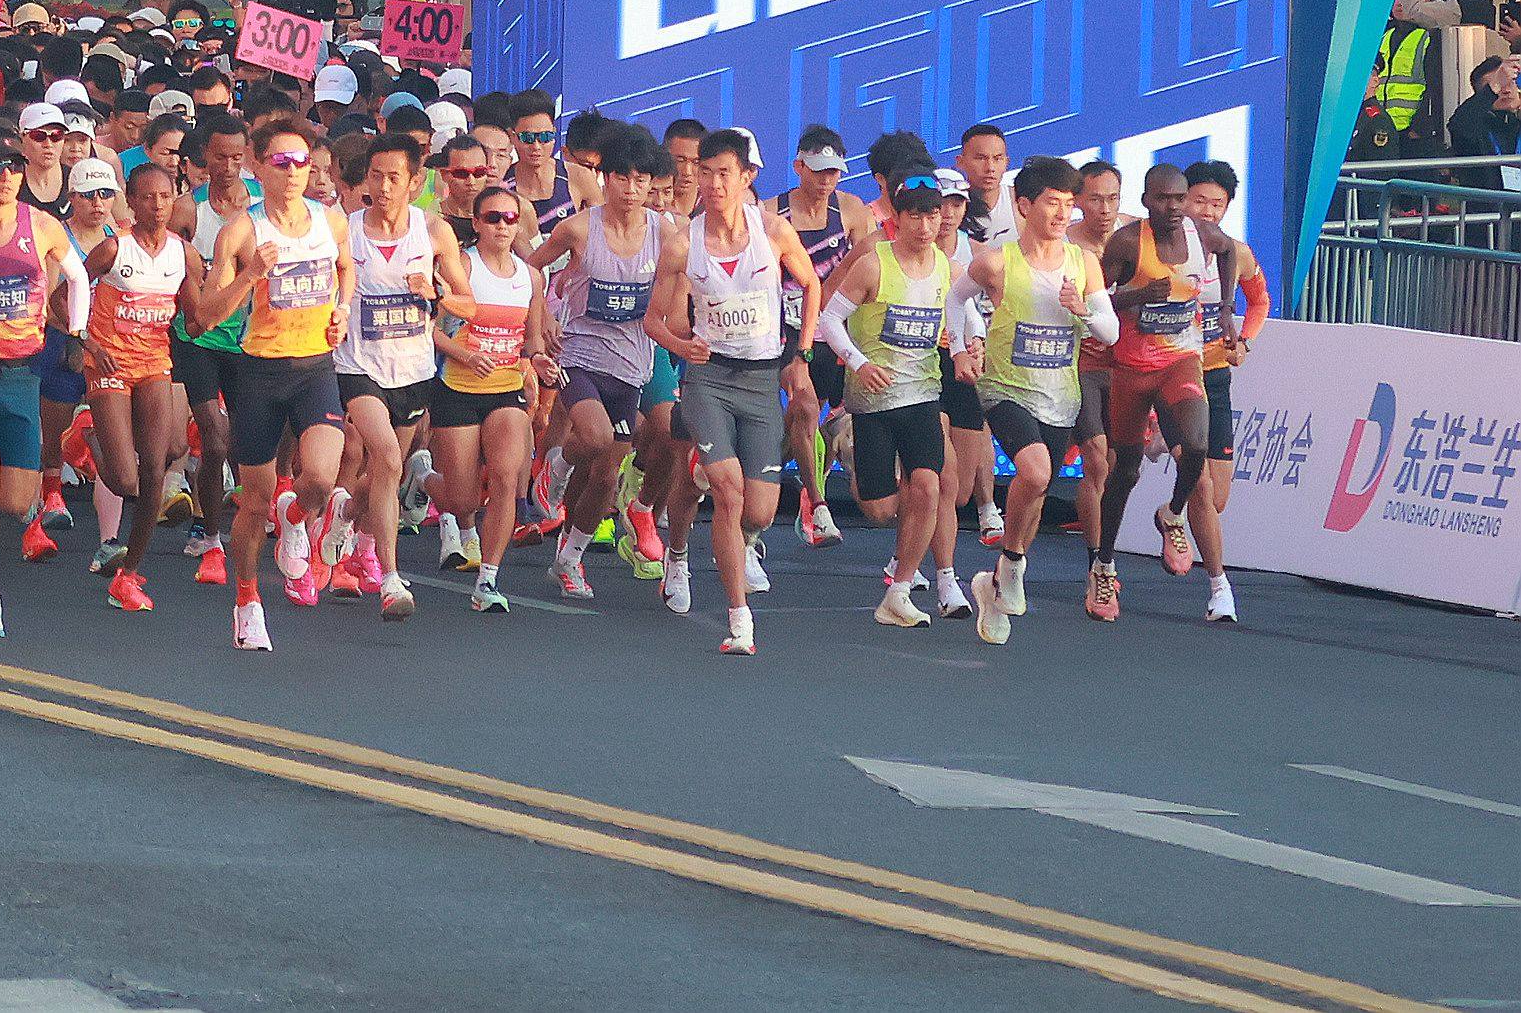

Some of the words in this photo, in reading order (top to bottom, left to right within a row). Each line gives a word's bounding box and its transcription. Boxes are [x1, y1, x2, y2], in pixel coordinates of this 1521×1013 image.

[251, 10, 311, 60] 3:00
[394, 4, 454, 46] 4:00
[606, 296, 636, 311] 马瑞
[707, 308, 758, 327] A10002
[1392, 408, 1521, 510] 东浩兰生
[1381, 500, 1439, 529] DONGHAO
[1439, 506, 1503, 538] LANSHENG
